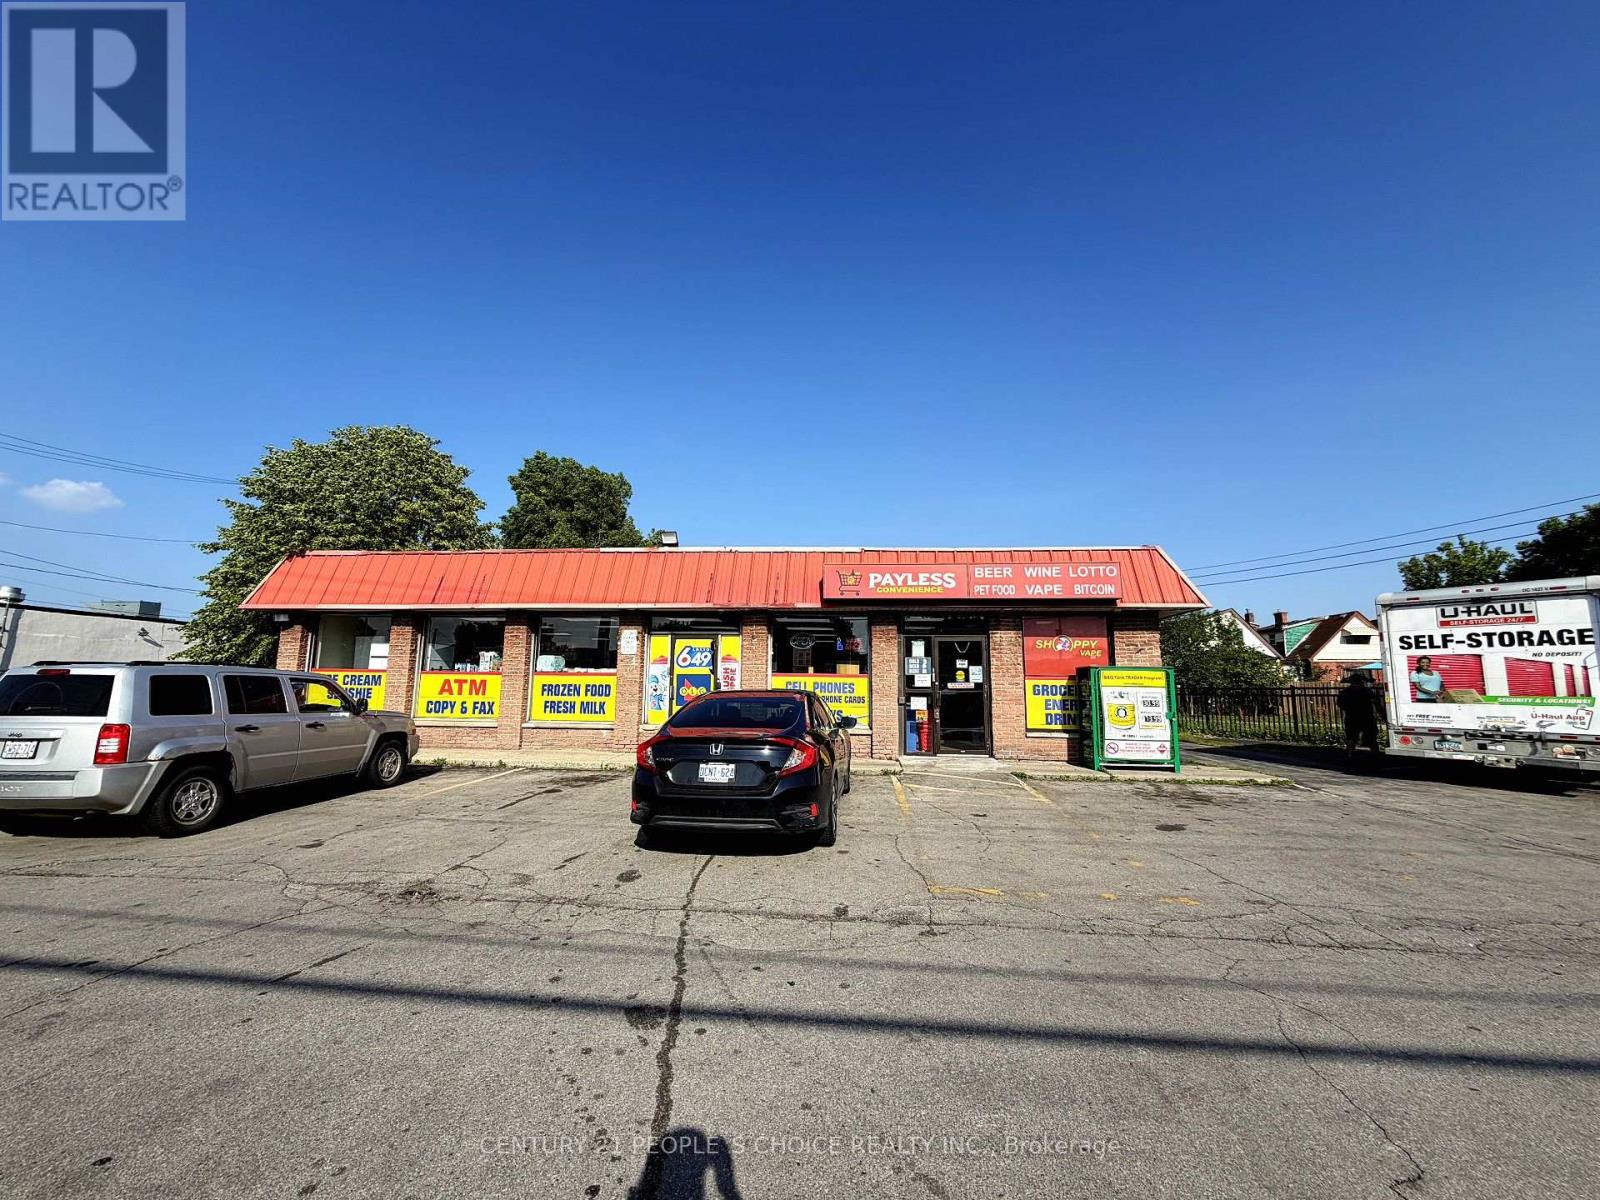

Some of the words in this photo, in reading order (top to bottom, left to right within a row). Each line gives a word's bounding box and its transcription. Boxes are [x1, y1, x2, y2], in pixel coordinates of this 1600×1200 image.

[974, 567, 1013, 578] BEER
[1024, 566, 1062, 577] WINE
[1069, 566, 1117, 577] LOTTO
[868, 573, 956, 588] PAYLESS
[974, 585, 989, 595] PET
[992, 585, 1015, 595] FOOD
[1025, 584, 1063, 595] VAPE
[1074, 584, 1115, 595] BITCOIN
[1440, 602, 1533, 618] U-HAUL
[1449, 618, 1505, 626] SELF-STORAGE
[1399, 628, 1596, 650] SELF-STORAGE
[343, 675, 382, 686] CREAM
[722, 667, 730, 688] USH
[327, 688, 373, 699] SSHIE
[438, 679, 487, 696] ATM
[541, 684, 580, 697] FROZEN
[585, 684, 611, 697] FOOD
[813, 682, 855, 693] PHONES
[1032, 685, 1080, 696] GROCE
[845, 696, 866, 704] CARDS
[1044, 699, 1079, 710] ENER
[426, 701, 456, 714] COPY
[460, 702, 467, 714] &
[472, 701, 494, 714] FAX
[543, 701, 575, 714] FRESH
[580, 701, 606, 714] MILK
[1045, 713, 1079, 725] DRIN
